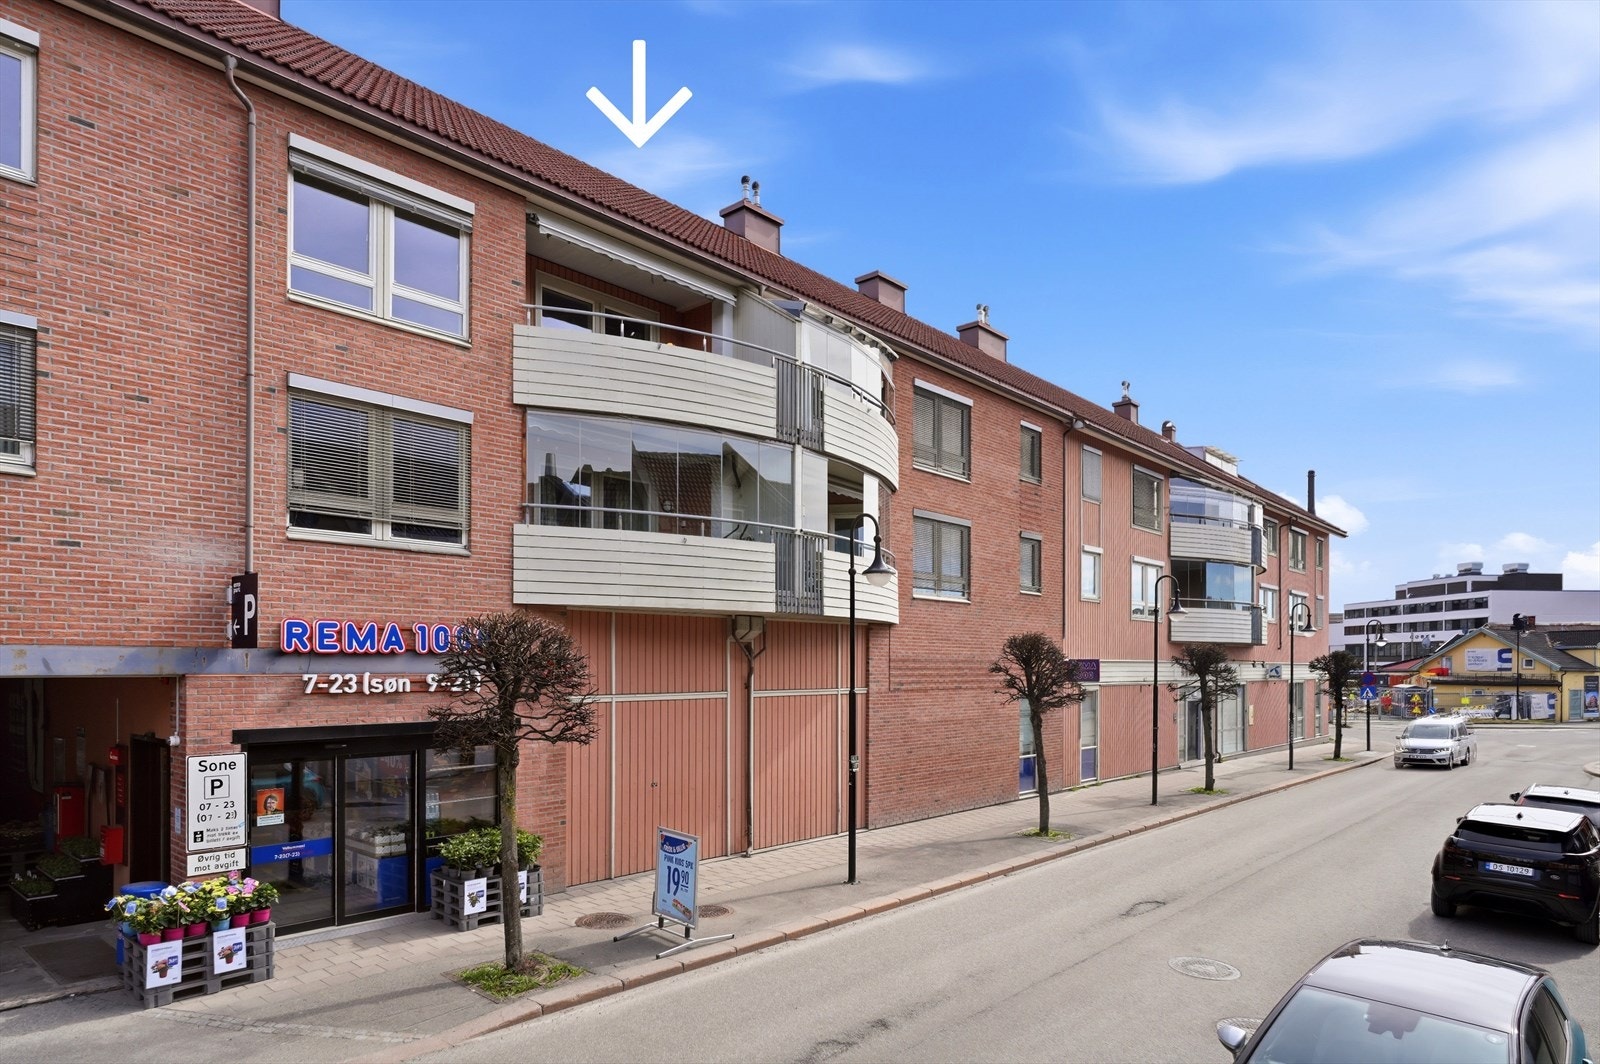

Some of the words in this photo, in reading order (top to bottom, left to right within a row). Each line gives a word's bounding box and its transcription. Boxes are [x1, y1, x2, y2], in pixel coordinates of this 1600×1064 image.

[244, 593, 256, 635] P
[281, 618, 405, 654] REMA
[302, 673, 358, 694] 7-23
[362, 672, 410, 696] (søn
[198, 760, 237, 772] Sone
[210, 778, 224, 796] P
[199, 802, 212, 811] 07
[223, 801, 235, 809] 23
[197, 813, 213, 823] (07
[194, 864, 211, 872] mot
[214, 860, 239, 869] avgift
[667, 865, 680, 896] 19
